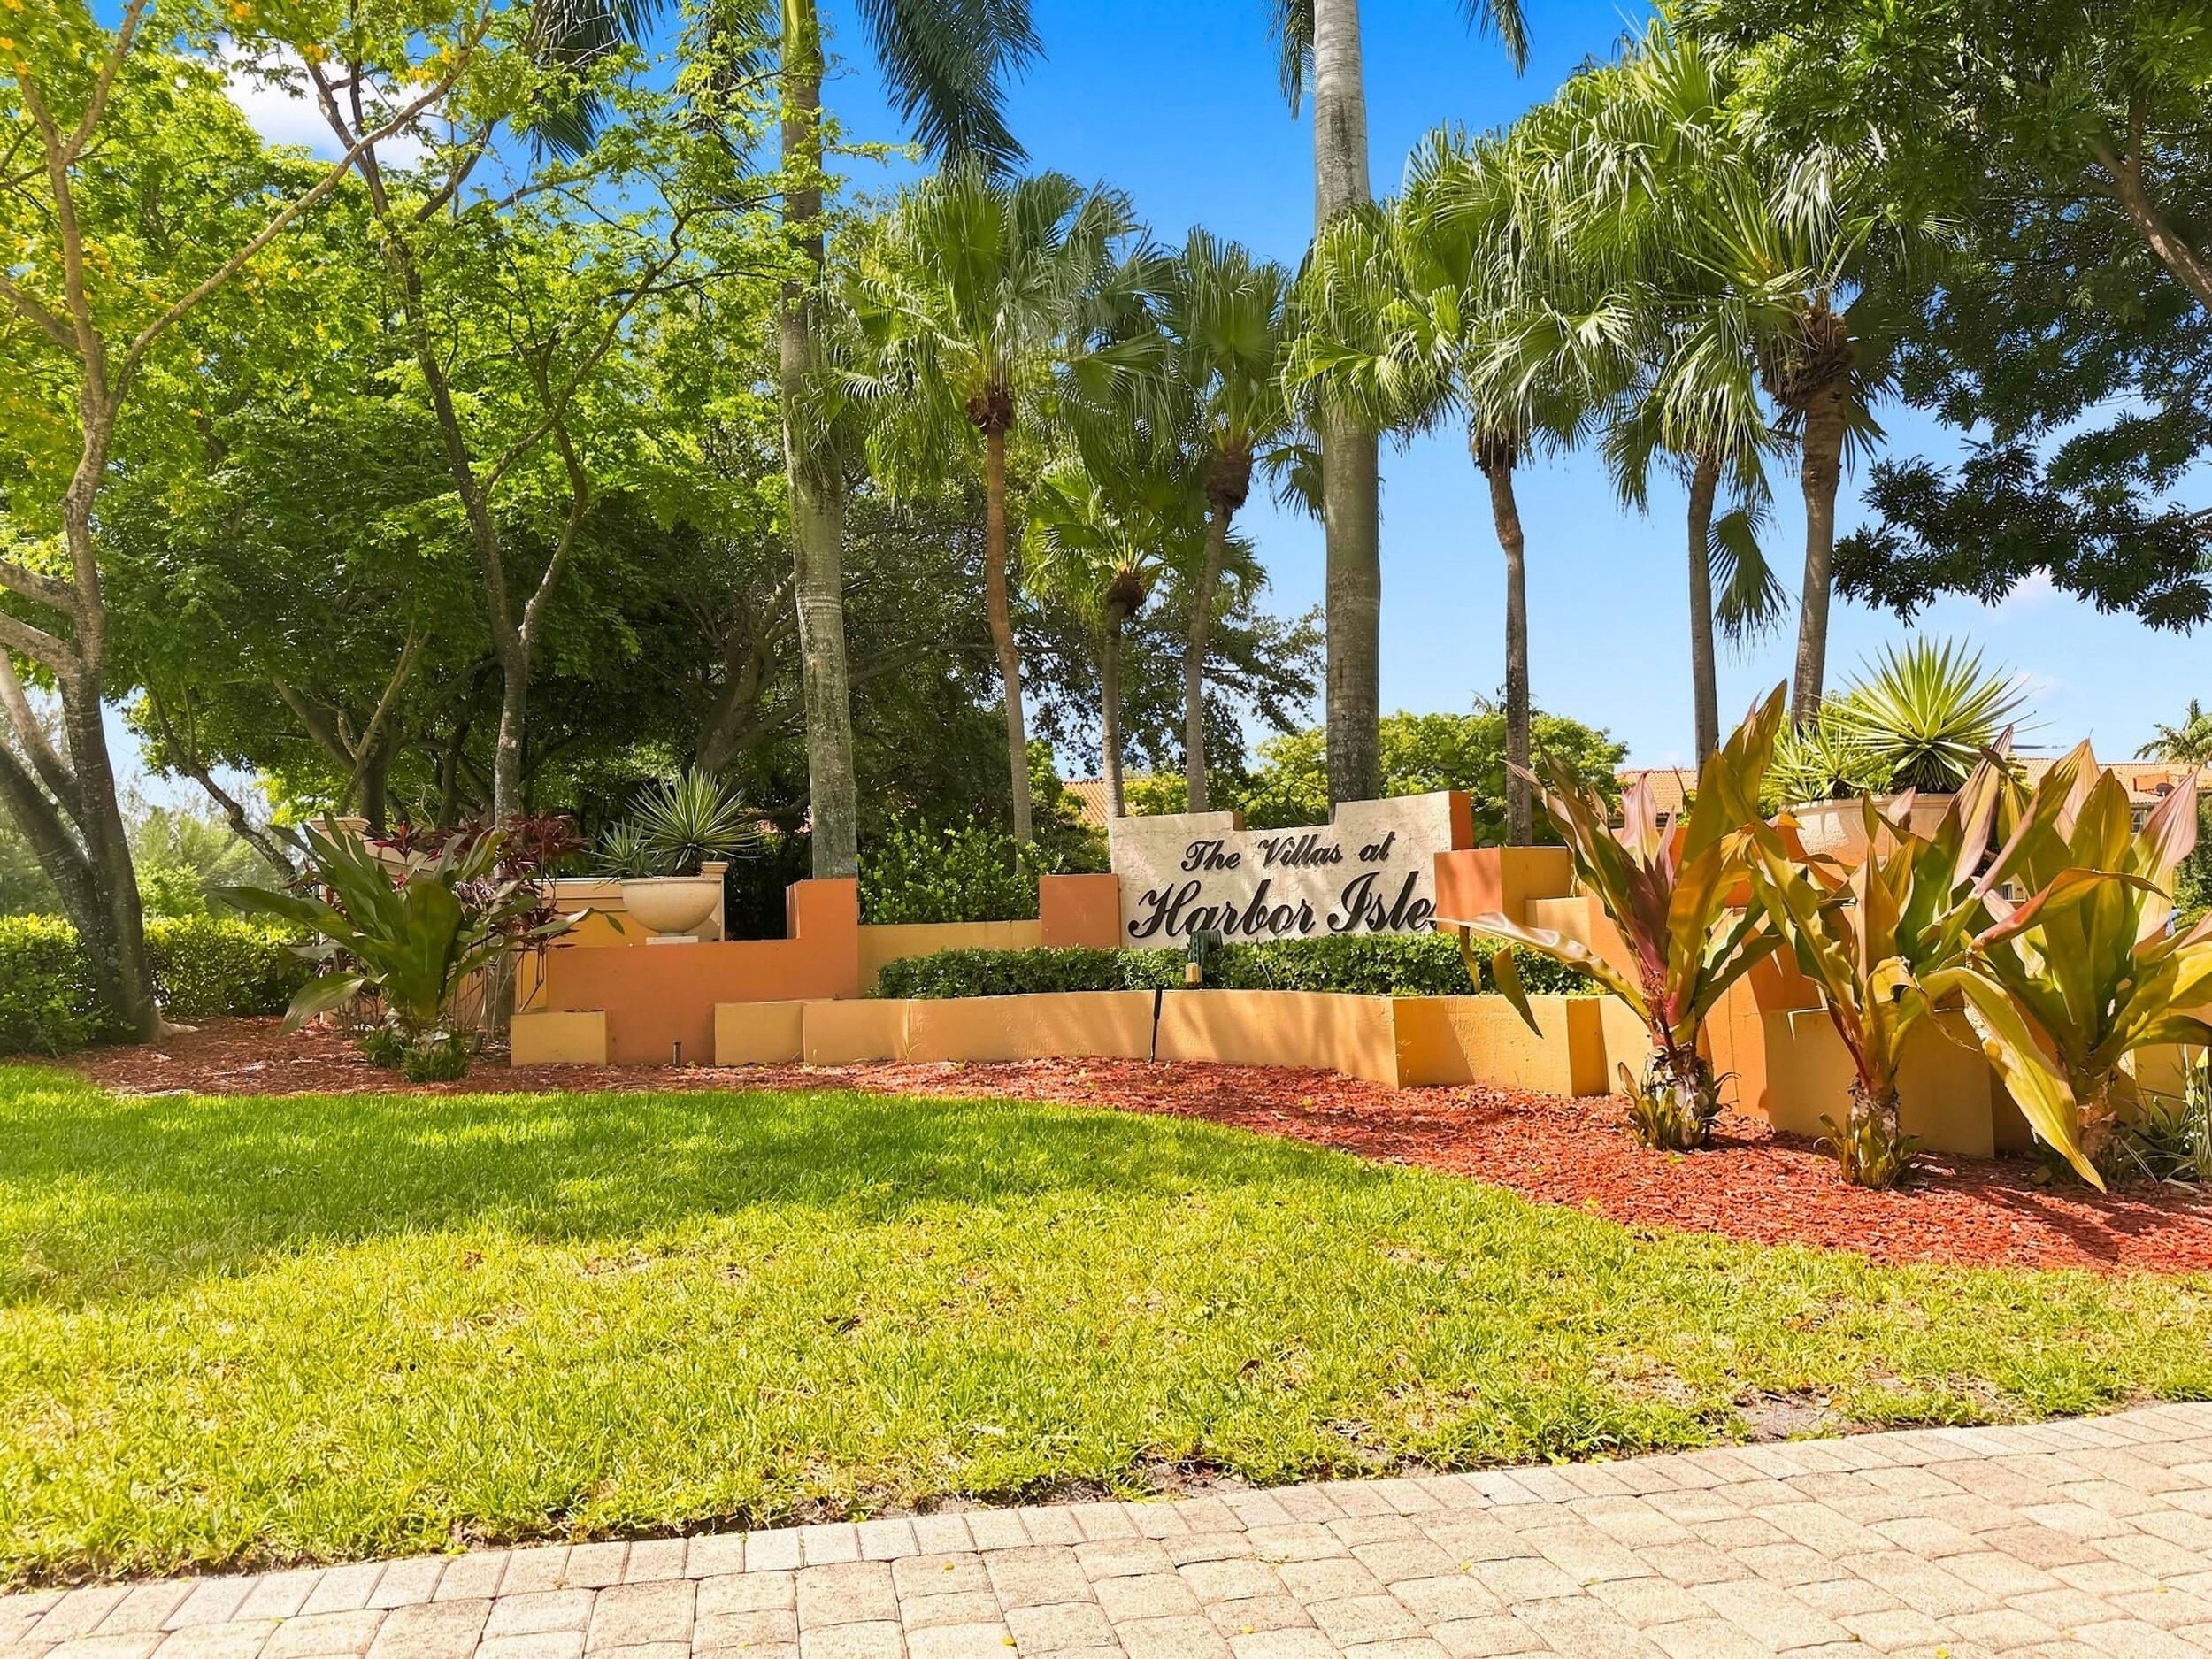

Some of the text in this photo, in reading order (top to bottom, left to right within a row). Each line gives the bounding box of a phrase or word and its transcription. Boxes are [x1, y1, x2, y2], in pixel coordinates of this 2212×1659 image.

[1181, 831, 1395, 872] The Villas at
[1128, 879, 1316, 938] Harbor
